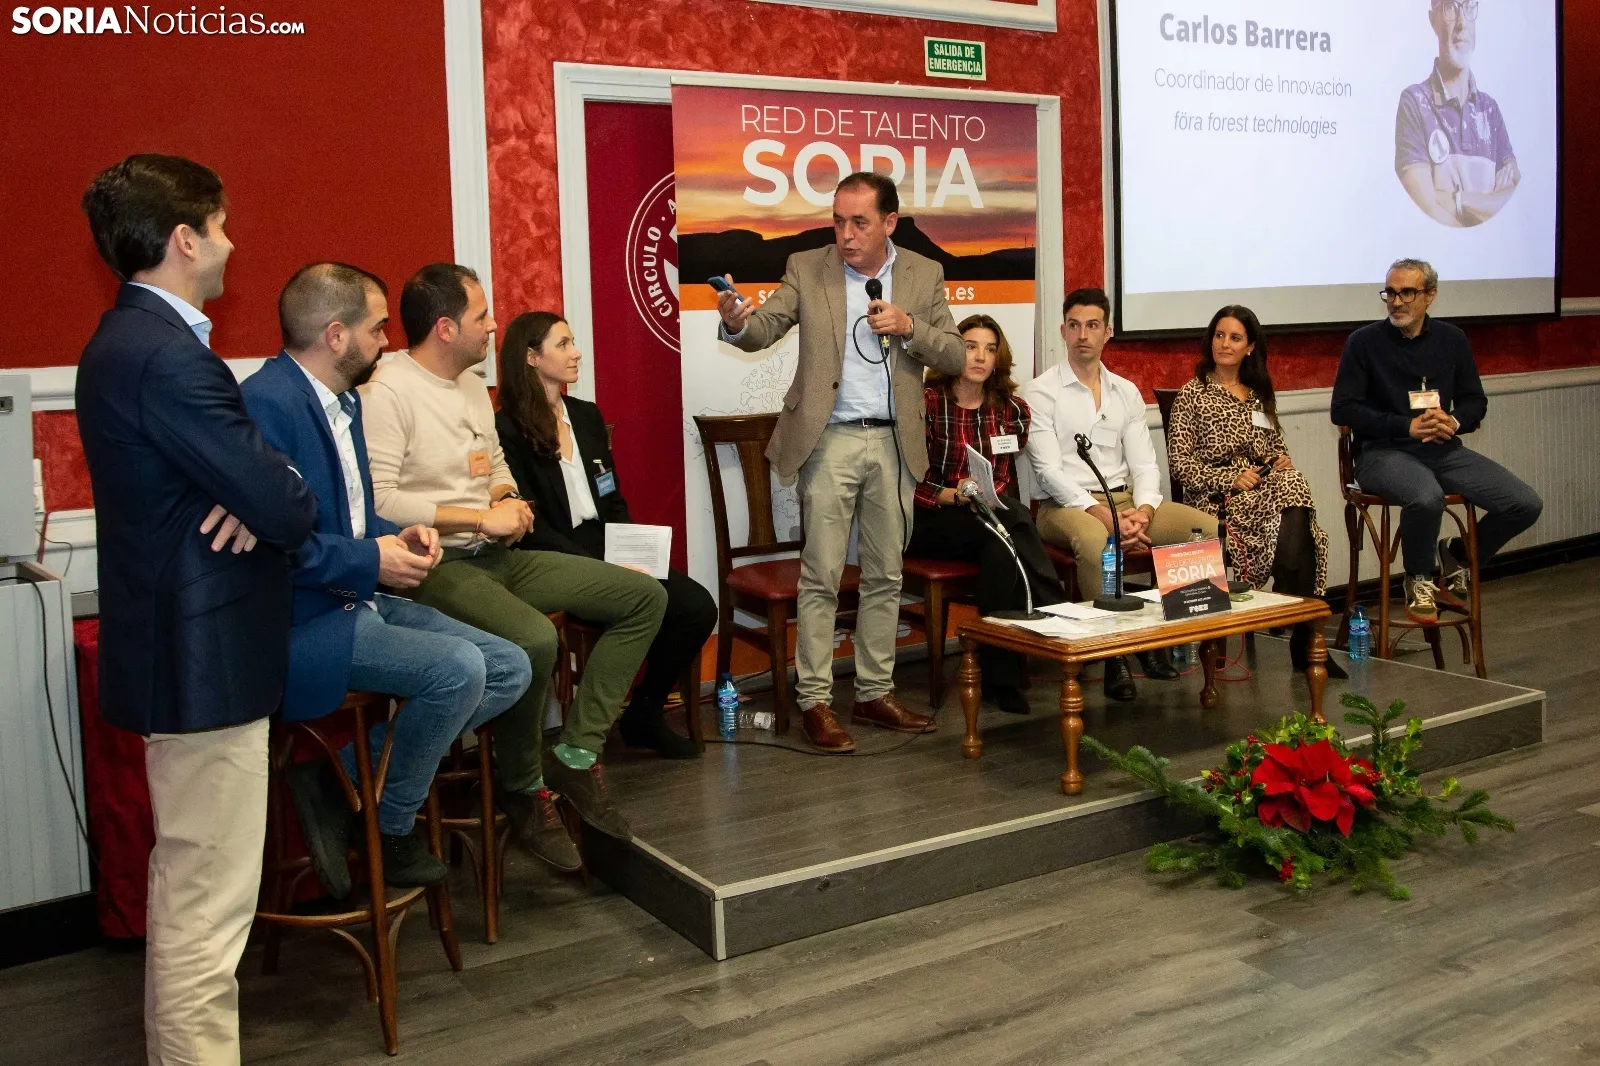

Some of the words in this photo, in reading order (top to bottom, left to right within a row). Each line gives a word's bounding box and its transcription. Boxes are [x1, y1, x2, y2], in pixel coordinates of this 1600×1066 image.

[1159, 12, 1238, 46] Carlos
[1245, 19, 1332, 53] Barrera
[929, 57, 982, 73] EMERGENCIA
[934, 43, 963, 57] SALIDA
[964, 46, 976, 59] DE
[1154, 68, 1250, 92] Coordinador
[1254, 73, 1274, 93] de
[1277, 74, 1352, 98] Innovación
[741, 104, 806, 134] RED
[814, 108, 854, 137] DE
[860, 110, 986, 142] TALENTO
[1173, 110, 1203, 132] föra
[1207, 111, 1249, 133] forest
[1252, 114, 1338, 139] technologies
[742, 138, 985, 208] SORIA
[642, 226, 673, 318] CÍRCULO
[1167, 563, 1217, 584] SORIA
